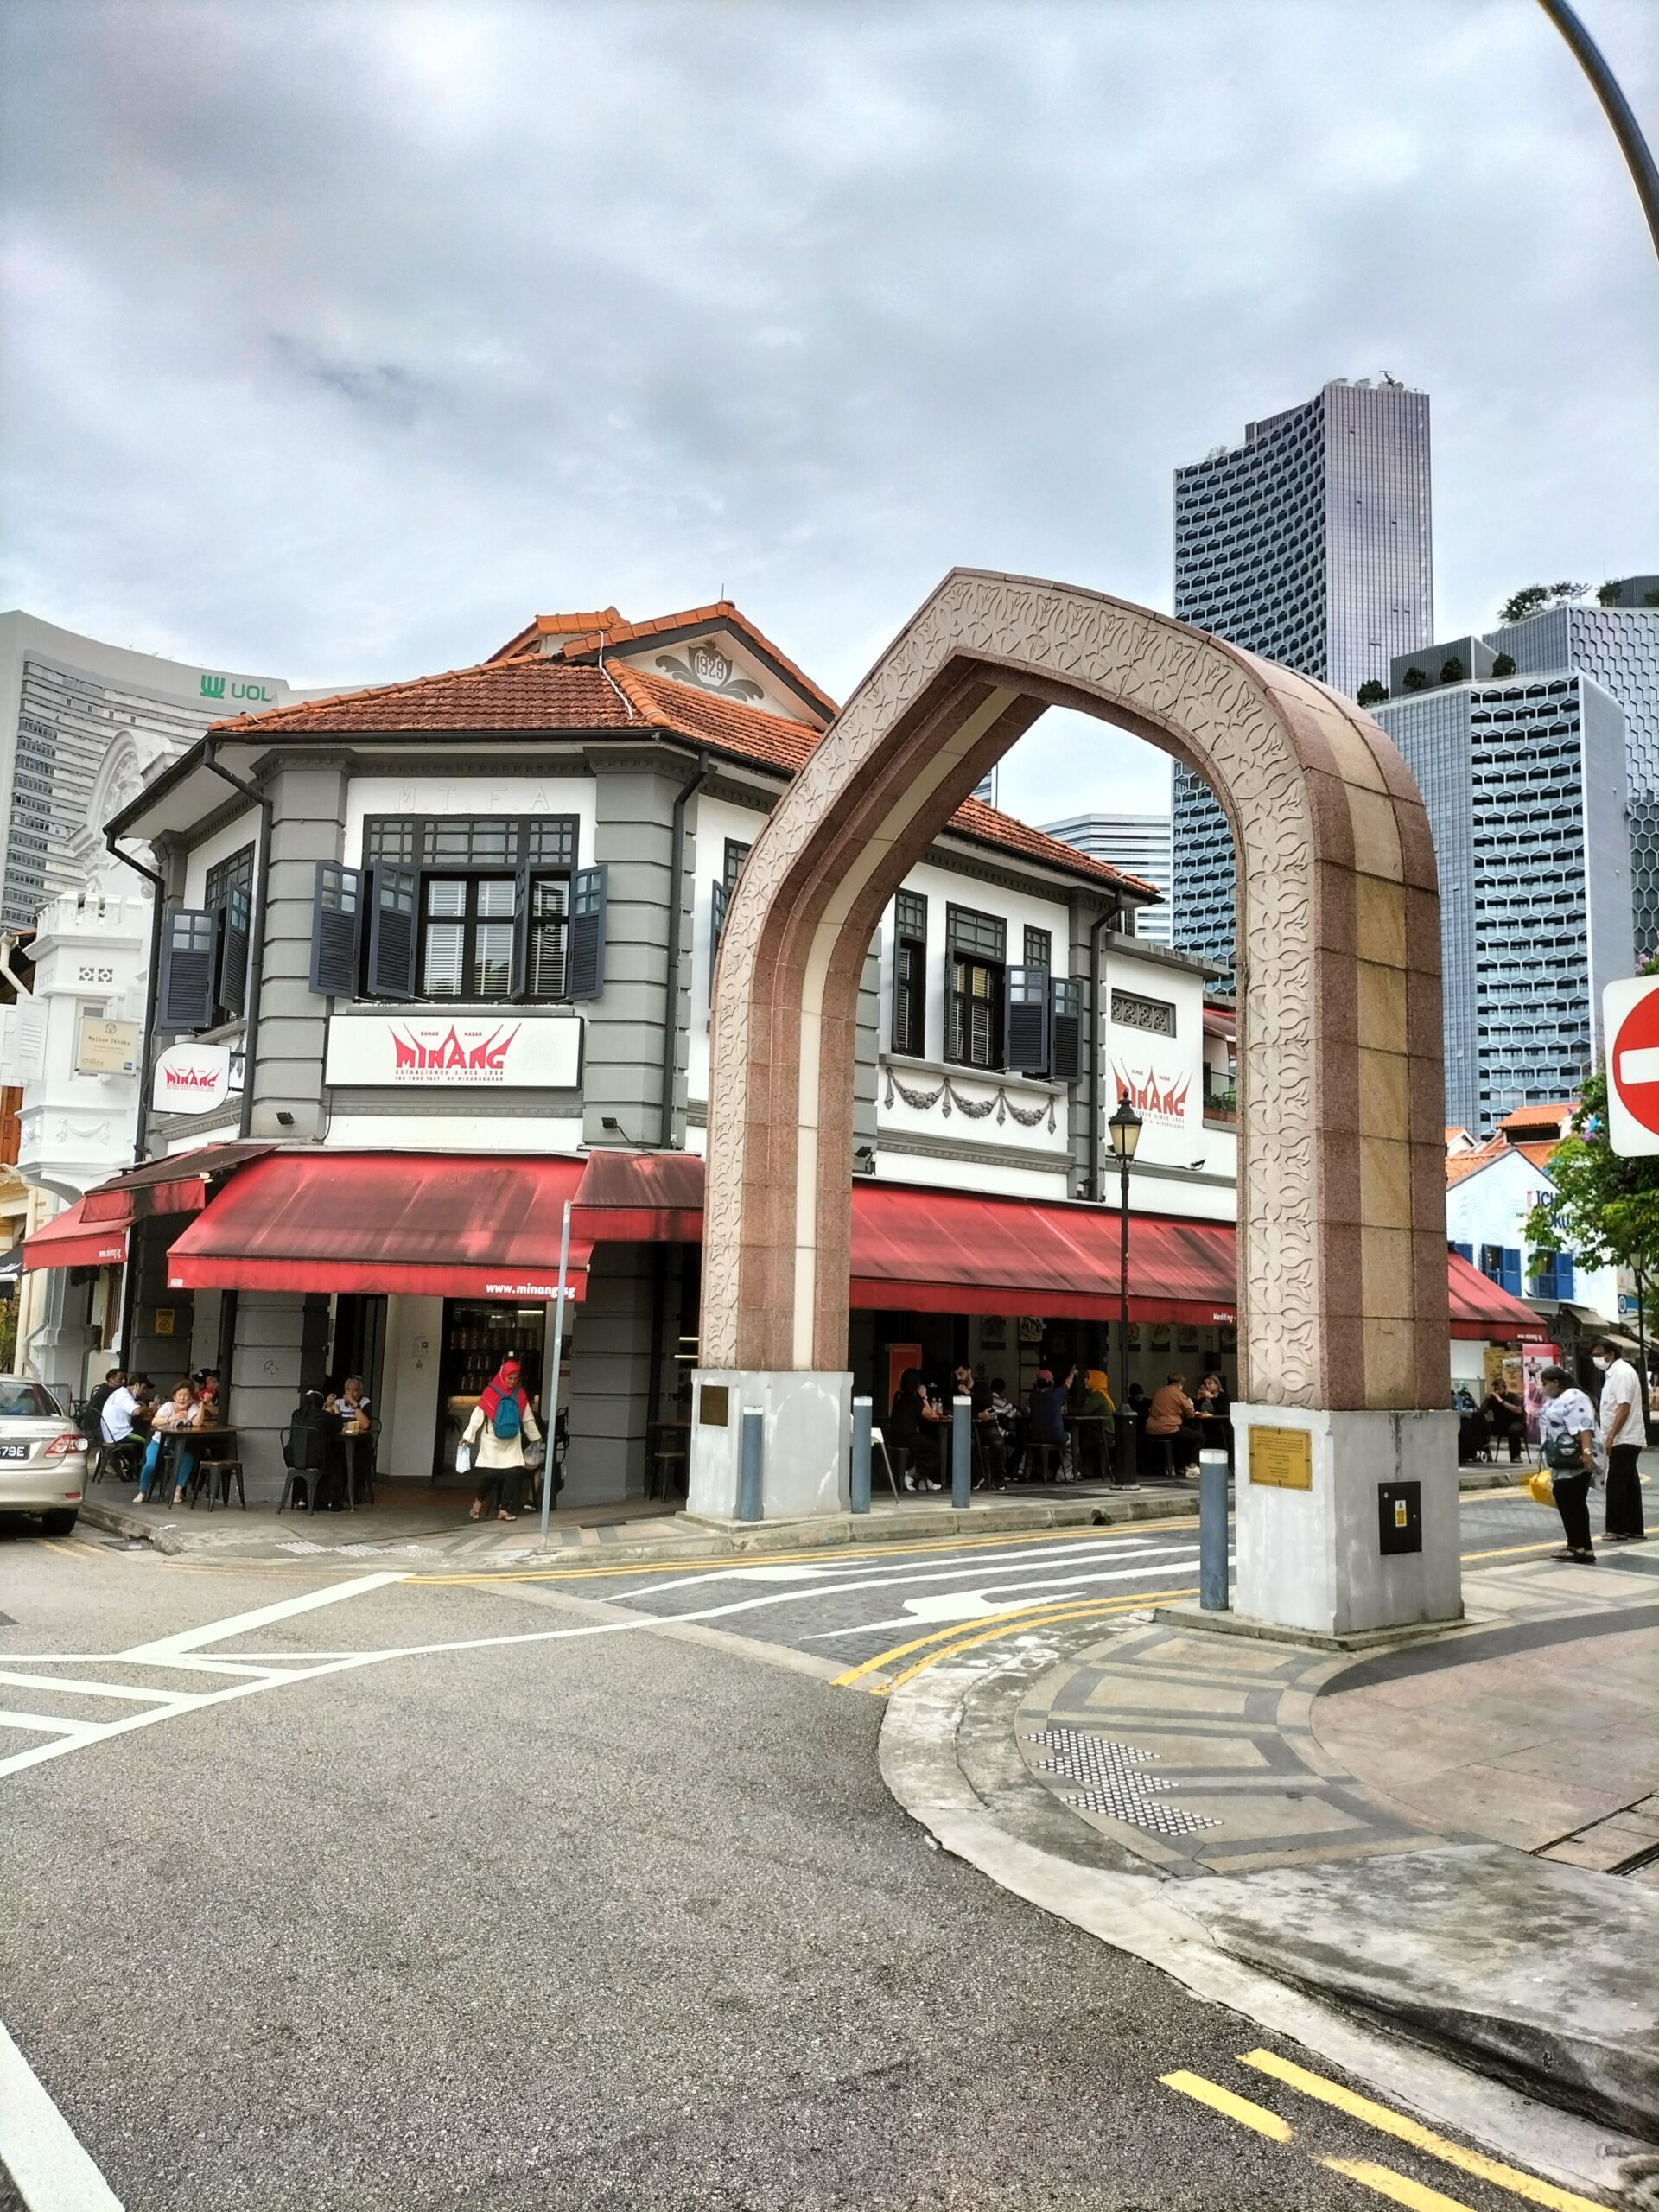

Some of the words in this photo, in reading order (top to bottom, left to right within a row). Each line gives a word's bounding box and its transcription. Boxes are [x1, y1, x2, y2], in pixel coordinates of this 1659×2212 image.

[696, 655, 725, 680] 1929
[232, 683, 272, 702] UOL
[387, 1023, 521, 1069] MINANG
[163, 1064, 222, 1087] MINANG
[486, 1283, 576, 1299] www.minangsg
[0, 1446, 25, 1458] 79E
